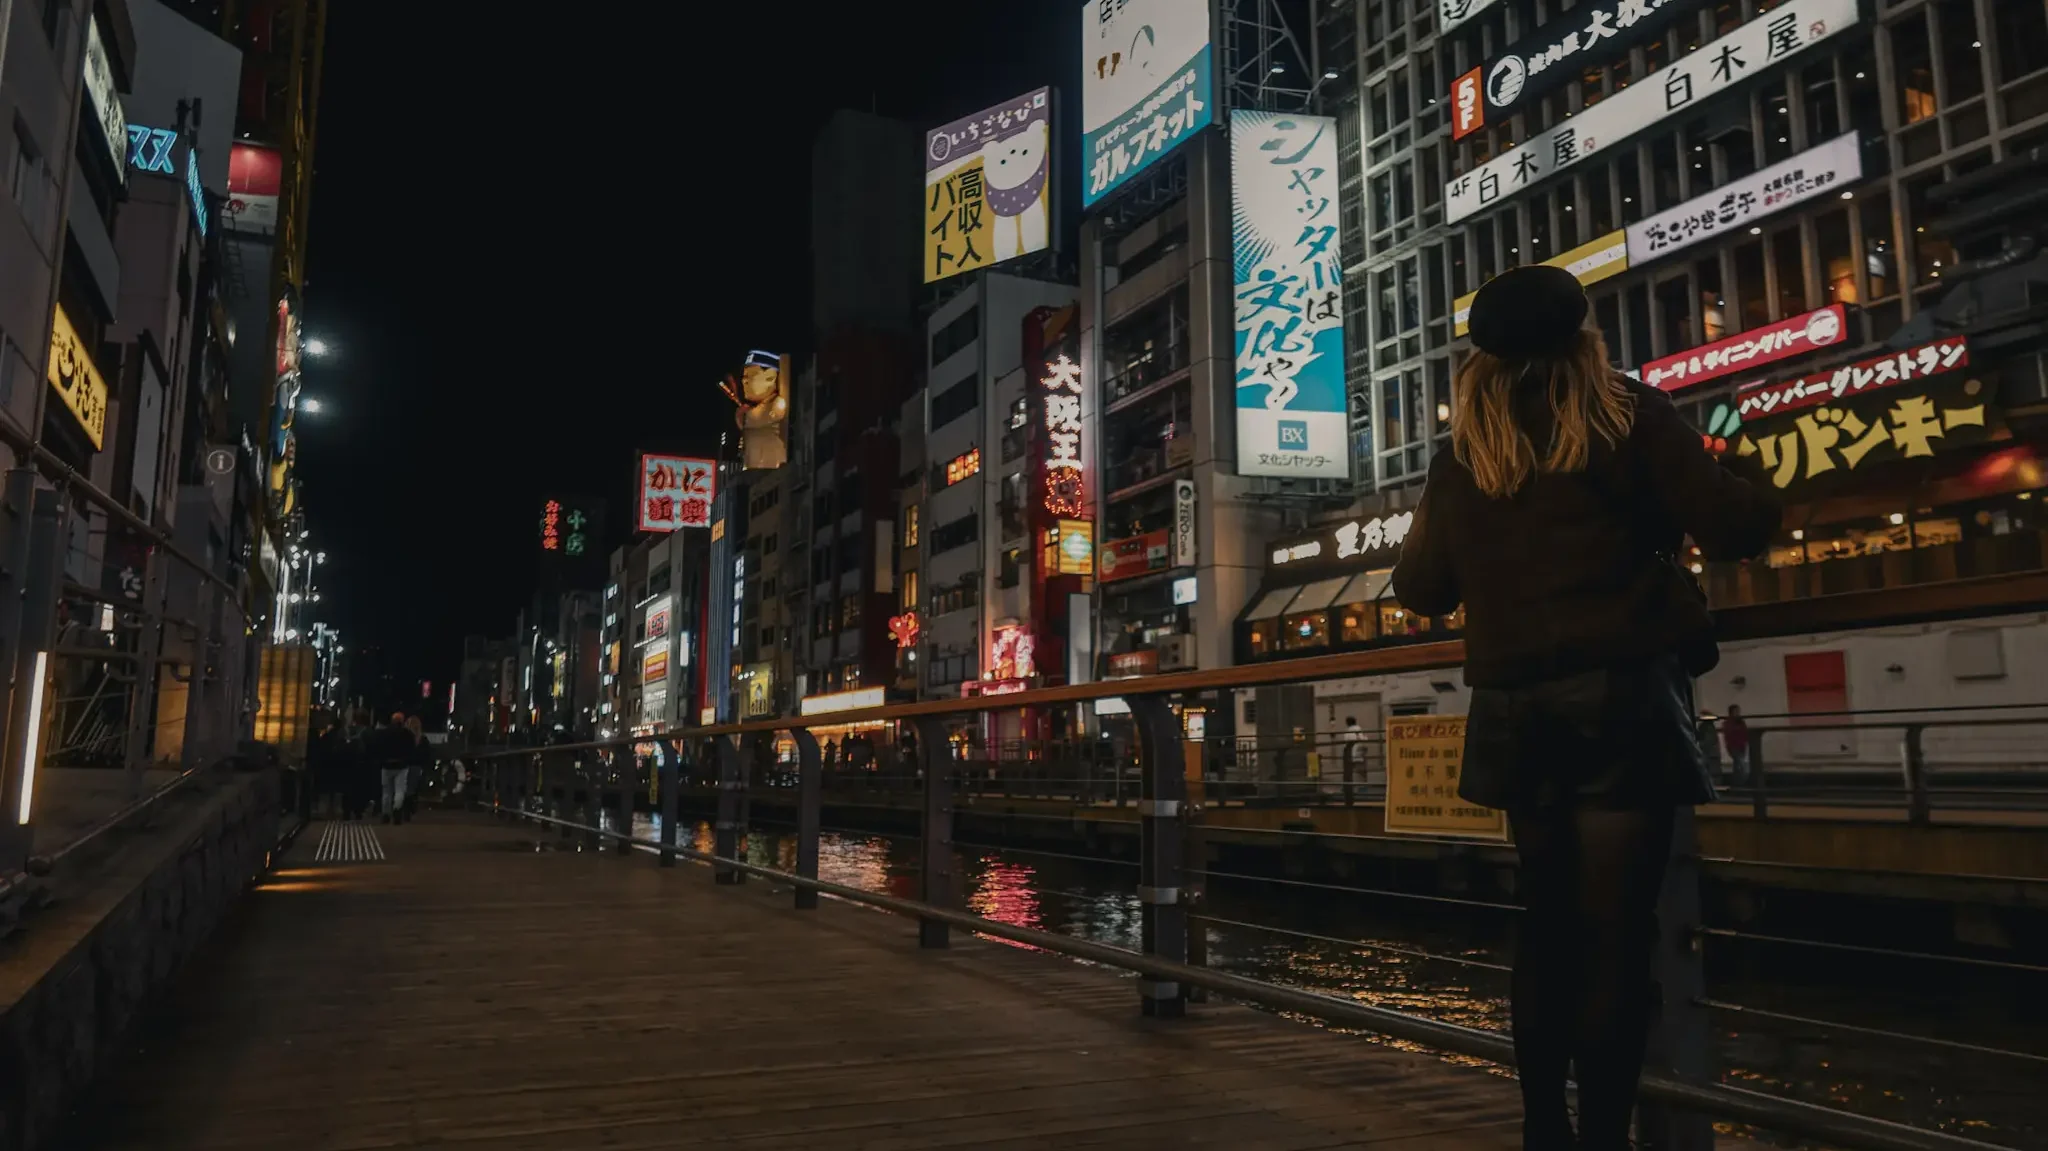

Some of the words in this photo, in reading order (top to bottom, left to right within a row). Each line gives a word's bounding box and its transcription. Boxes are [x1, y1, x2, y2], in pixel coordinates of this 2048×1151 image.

[1665, 12, 1803, 111] 白木屋
[951, 102, 1033, 146] いちごなび
[1457, 77, 1476, 130] 5F
[1090, 89, 1204, 195] ガルフネット
[1478, 128, 1581, 205] 白木屋
[957, 166, 984, 268] 高収入
[1450, 176, 1470, 199] 4F
[930, 174, 956, 276] バイト
[1740, 344, 1965, 414] ハンバーグレストラン
[1257, 453, 1333, 468] 文化シャッター
[1281, 427, 1304, 444] BX
[648, 463, 708, 494] かに
